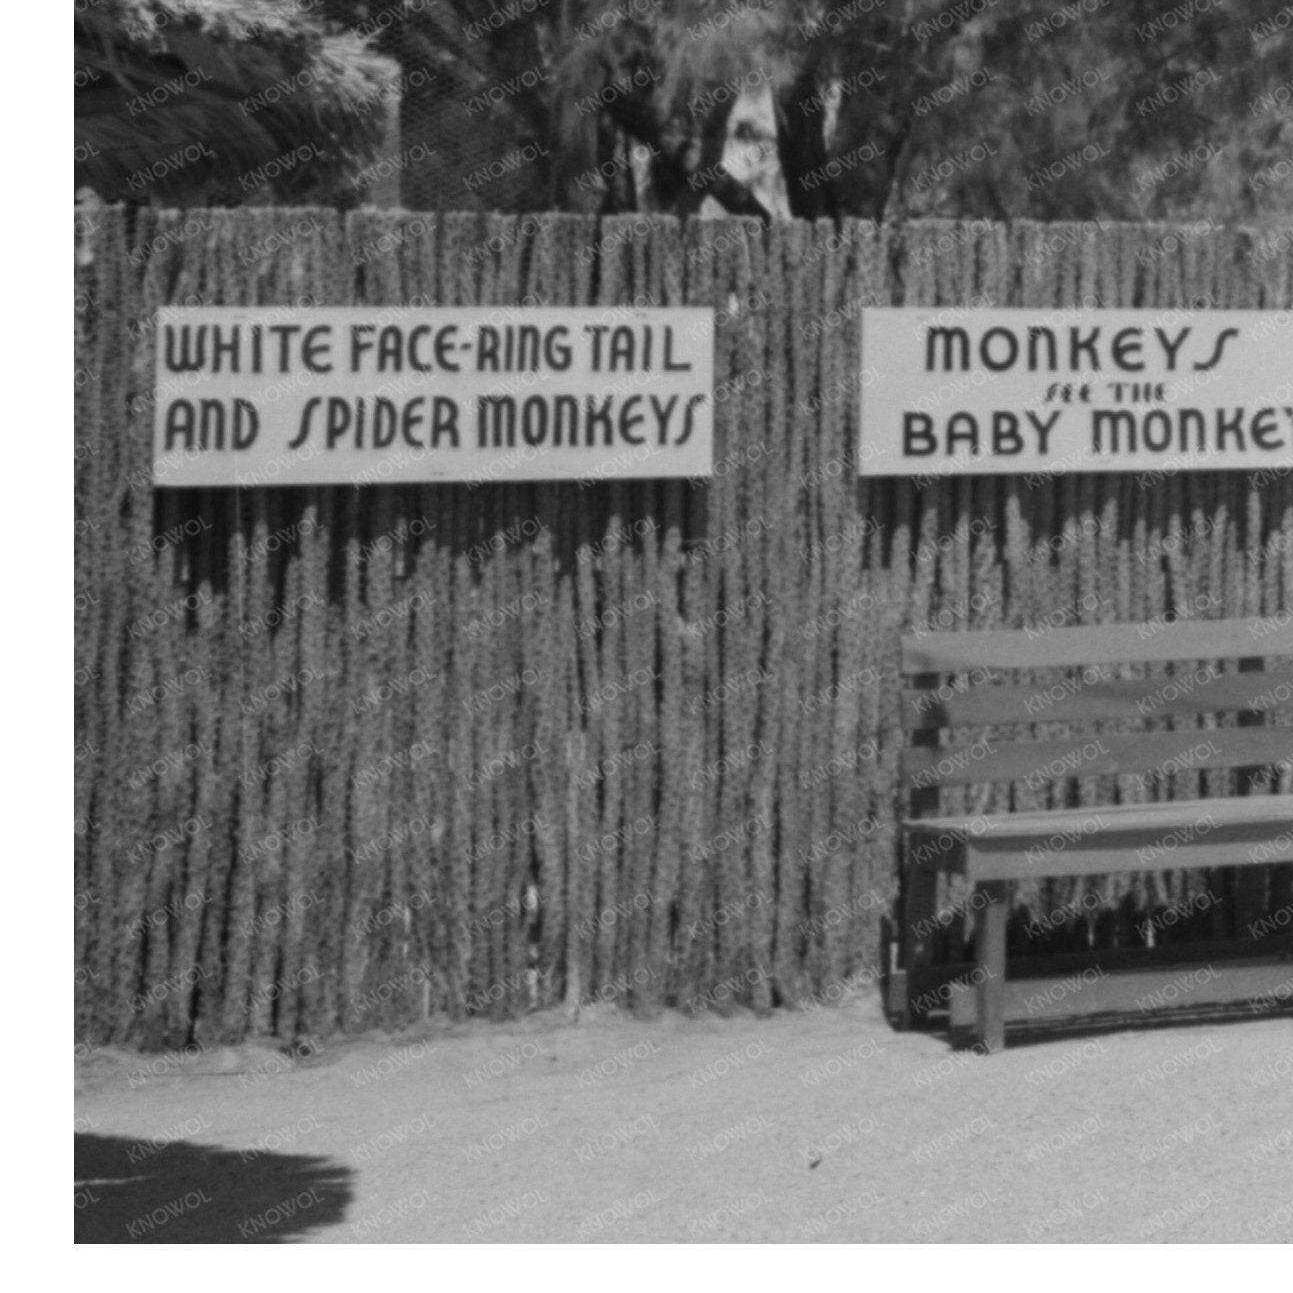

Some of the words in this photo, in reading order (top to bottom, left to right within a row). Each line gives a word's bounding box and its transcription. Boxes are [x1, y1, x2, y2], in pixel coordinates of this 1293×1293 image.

[163, 324, 334, 375] WHITE
[349, 324, 573, 374] FACE-RING
[583, 324, 692, 373] TAIL
[924, 325, 1240, 374] MONKEYS
[163, 397, 261, 453] AND
[287, 395, 461, 451] SPIDER
[476, 393, 706, 449] MONKEYS
[901, 409, 1062, 459] BABY
